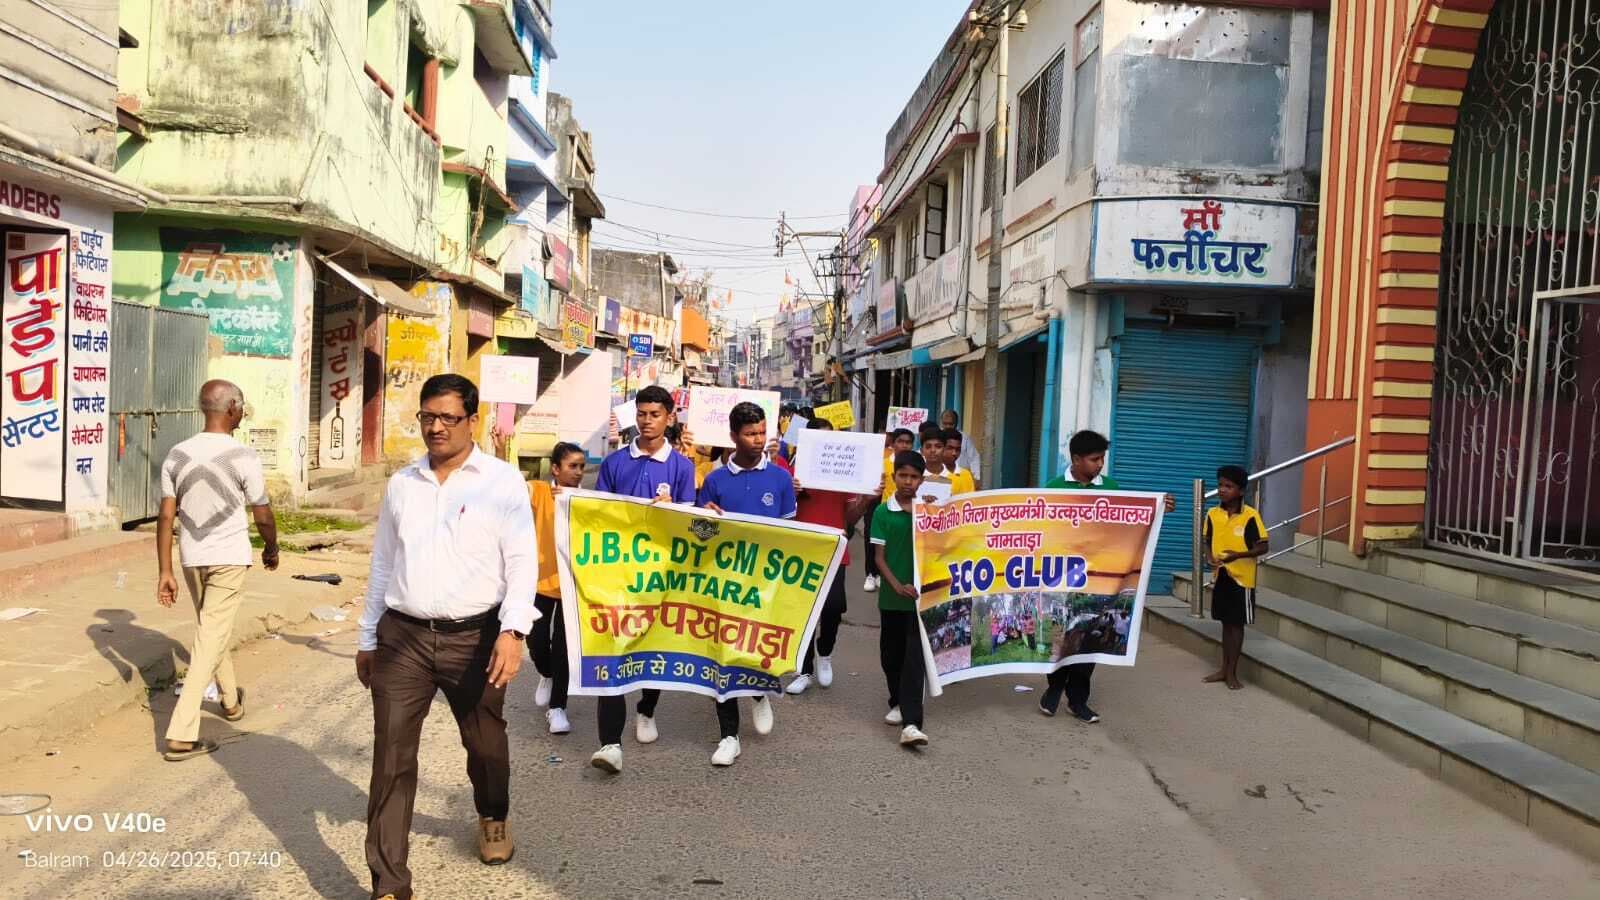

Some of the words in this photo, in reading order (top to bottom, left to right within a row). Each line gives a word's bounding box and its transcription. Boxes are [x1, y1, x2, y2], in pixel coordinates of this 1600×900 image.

[1181, 199, 1224, 231] माँ
[1131, 230, 1269, 274] फर्नीचर
[72, 329, 92, 351] पानी
[3, 408, 60, 447] सेन्टर
[990, 498, 1046, 528] मुख्यमंत्री
[1048, 504, 1095, 526] उत्कृष्ट
[1095, 499, 1152, 523] विद्यालय
[986, 533, 1042, 553] जामताड़ा
[575, 531, 660, 566] J.B.C.
[670, 536, 707, 568] DT
[715, 540, 760, 576] CM
[763, 548, 825, 593] SOE
[1005, 556, 1087, 589] CLUB
[627, 571, 762, 608] JAMTARA
[588, 602, 660, 639] जल
[660, 601, 795, 670] पखवाड़ा
[594, 664, 609, 681] 16
[650, 654, 667, 676] से
[673, 661, 695, 678] 30
